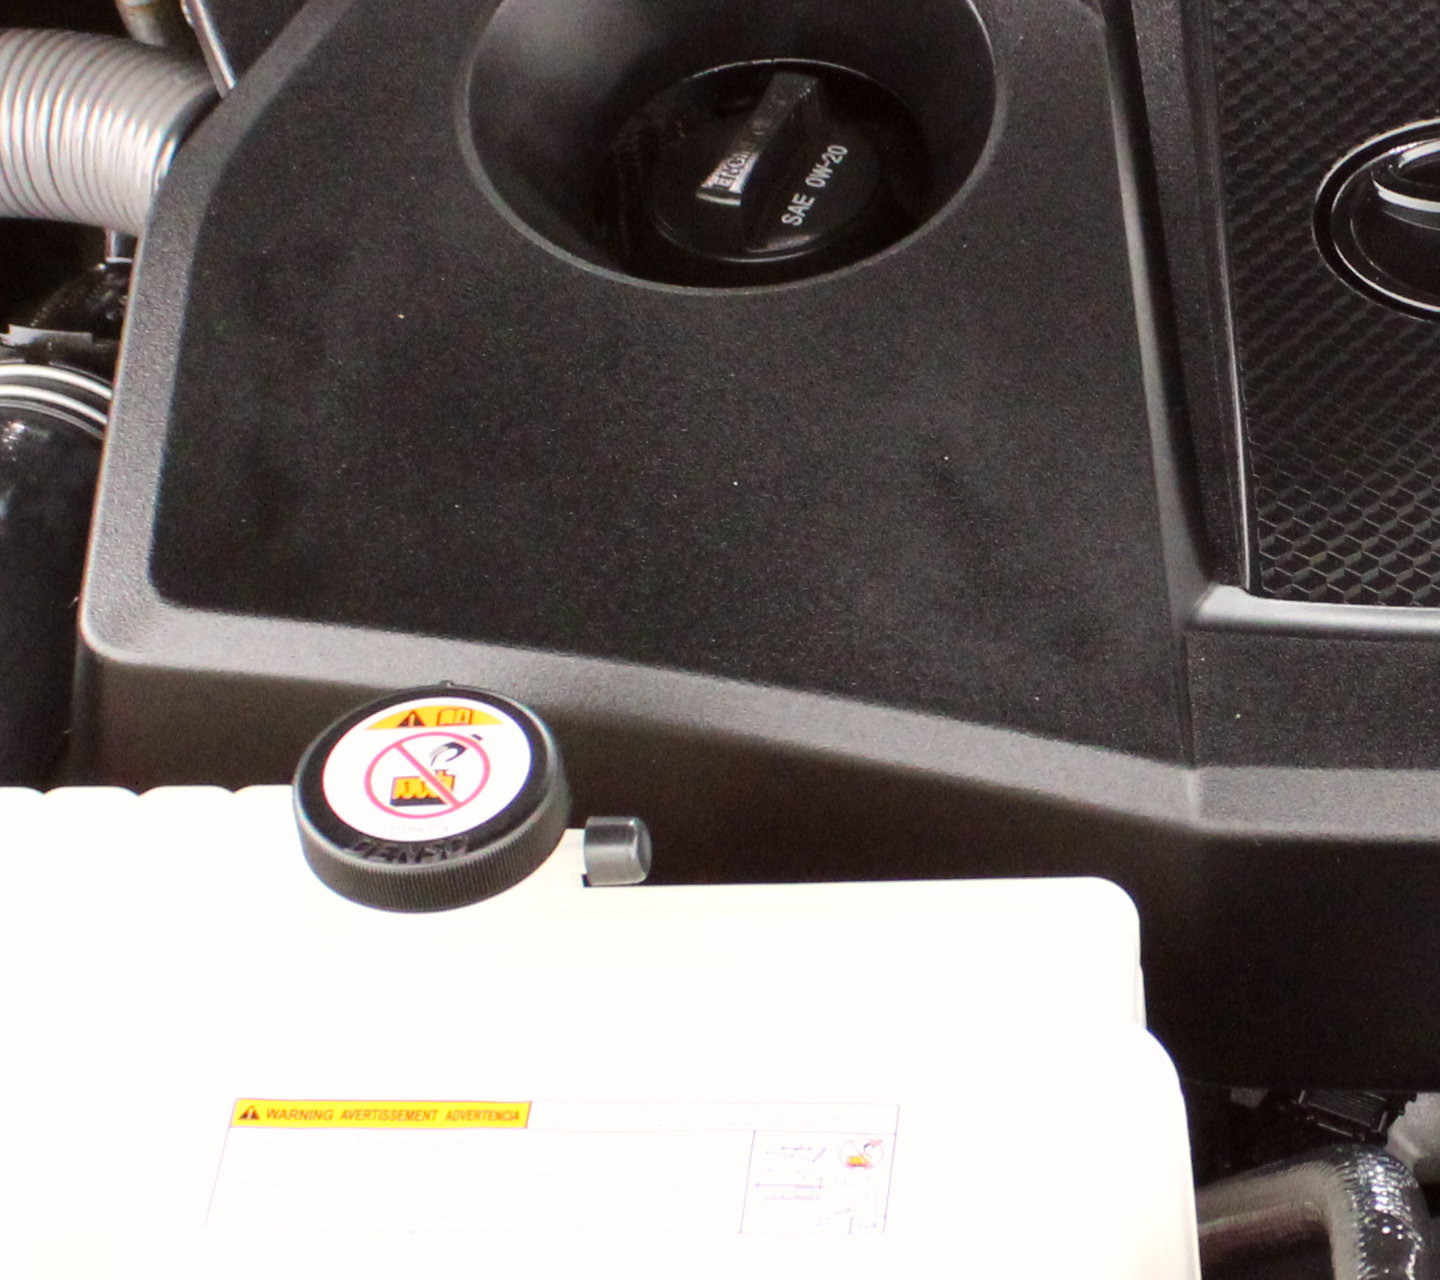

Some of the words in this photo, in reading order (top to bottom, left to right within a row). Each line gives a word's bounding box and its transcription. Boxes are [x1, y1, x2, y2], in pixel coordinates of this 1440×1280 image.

[781, 193, 816, 227] SAE
[804, 144, 848, 188] 0W-20
[350, 836, 469, 864] DENSO
[265, 1108, 335, 1122] WARNING
[338, 1108, 440, 1122] AVERTISSEMENT
[443, 1109, 521, 1122] ADVERTENCIA
